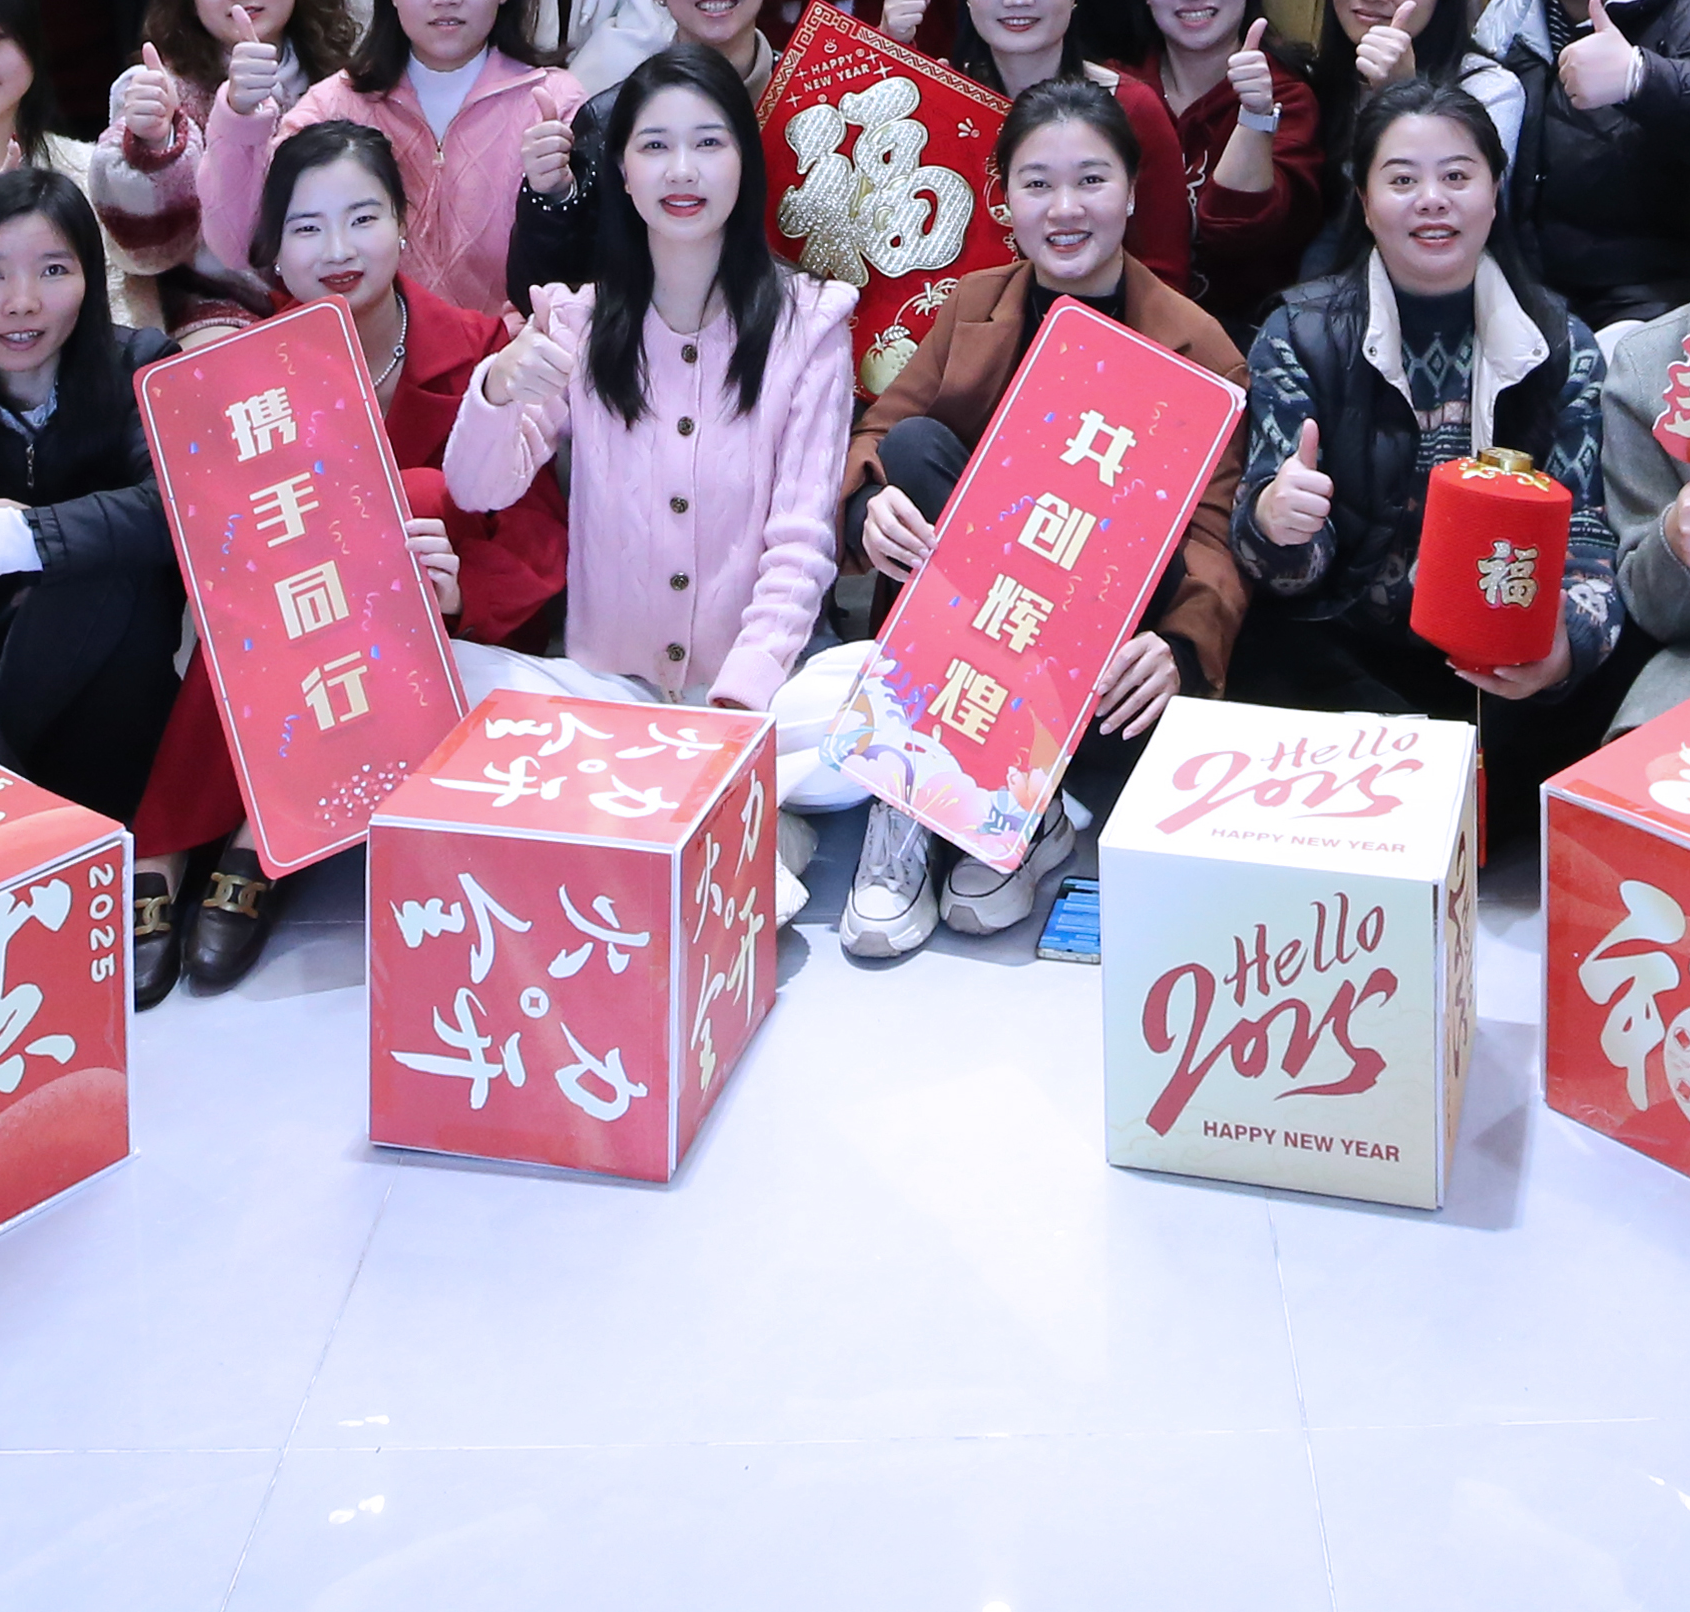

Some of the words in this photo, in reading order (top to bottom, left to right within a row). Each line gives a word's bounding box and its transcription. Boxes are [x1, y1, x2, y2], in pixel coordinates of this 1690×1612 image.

[803, 75, 832, 93] NEW
[836, 63, 870, 82] YEAR
[811, 53, 854, 75] HAPPY
[778, 77, 975, 288] 福
[220, 384, 373, 734] 携手同行
[925, 407, 1138, 747] 共创辉煌
[1477, 539, 1540, 610] 福
[1259, 726, 1421, 772] Hello
[1210, 828, 1285, 843] HAPPY
[1290, 834, 1342, 849] NEW
[1347, 840, 1407, 854] YEAR
[89, 862, 117, 984] 2025
[1223, 891, 1385, 1008] Hello
[1202, 1120, 1277, 1144] HAPPY
[1283, 1131, 1333, 1152] NEW
[1339, 1138, 1401, 1162] YEAR
